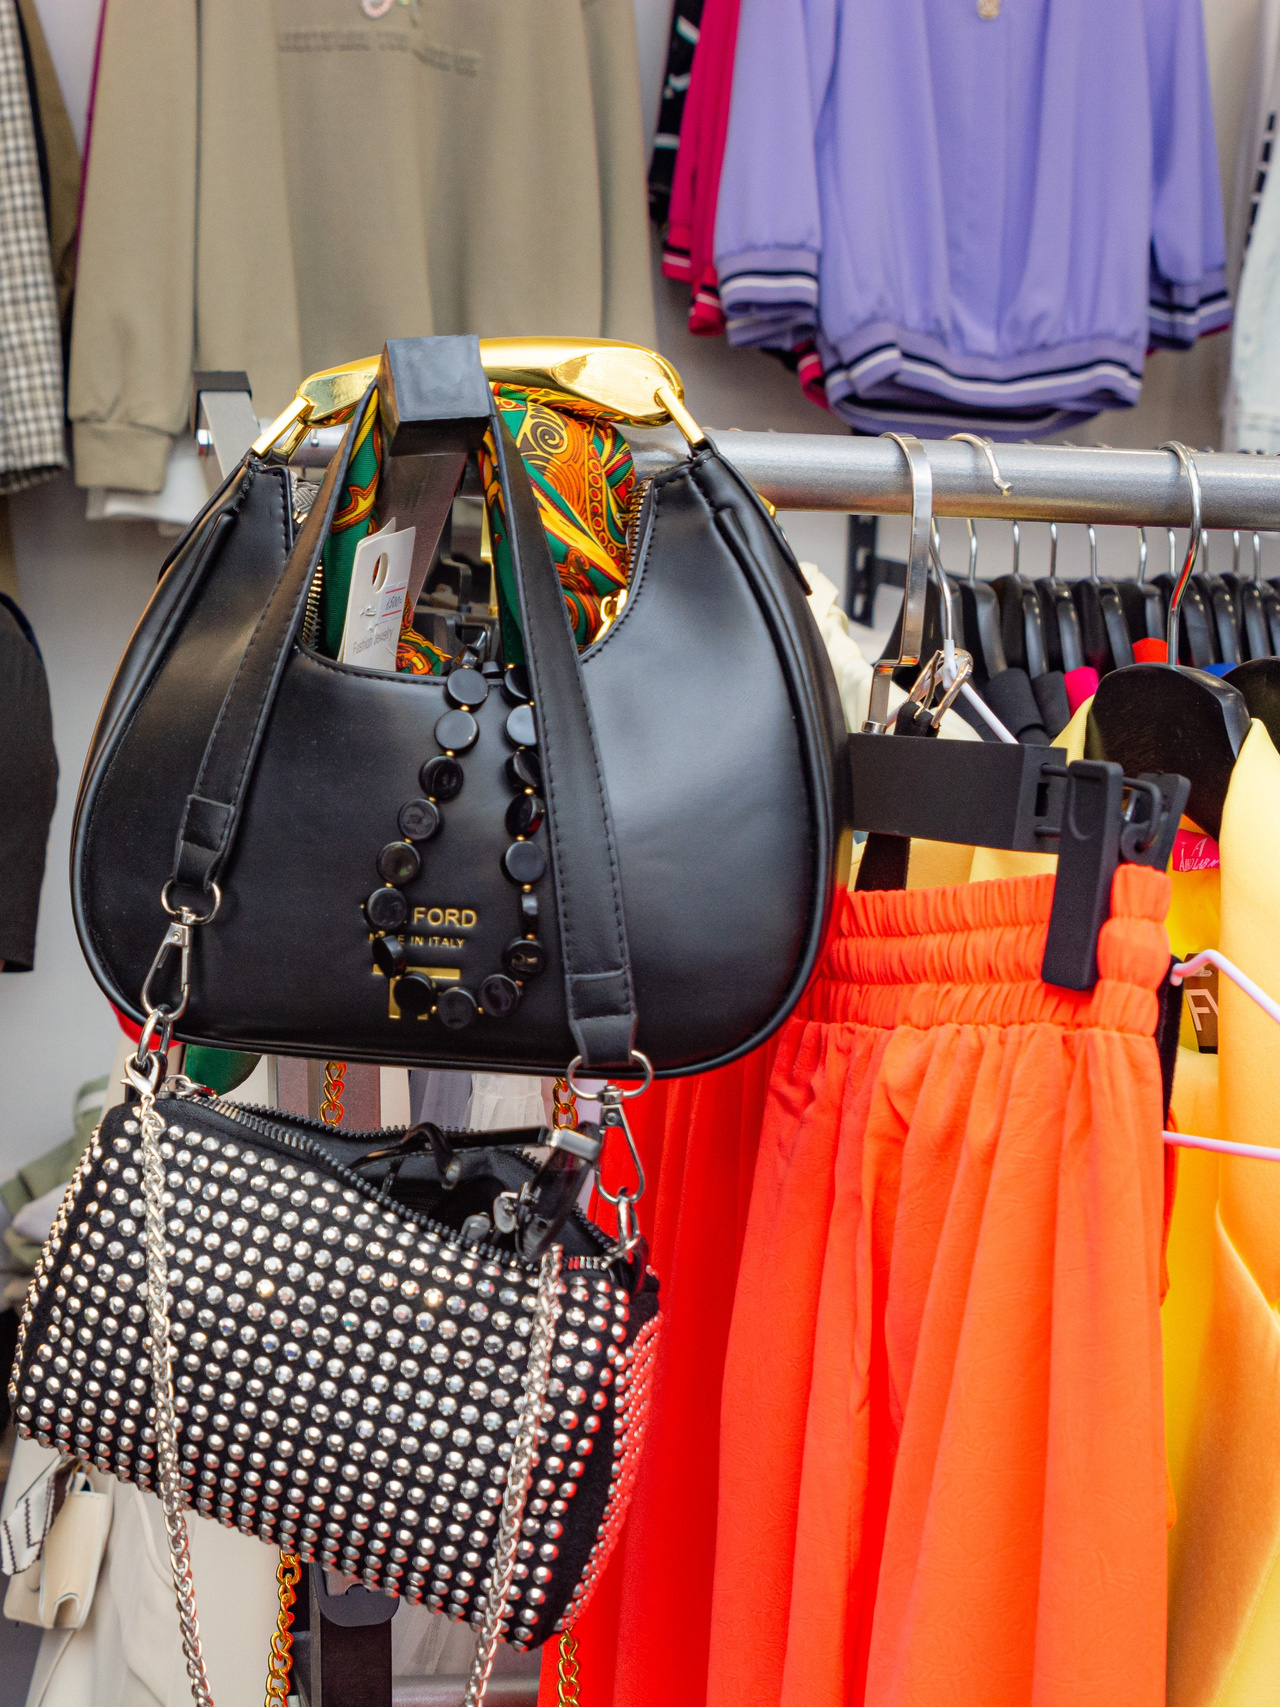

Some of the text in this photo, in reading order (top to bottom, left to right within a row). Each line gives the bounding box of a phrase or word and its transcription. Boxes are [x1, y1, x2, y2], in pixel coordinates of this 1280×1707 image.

[352, 636, 373, 655] Fashion
[413, 906, 478, 928] FORD
[410, 935, 425, 946] IN
[428, 936, 465, 949] ITALY
